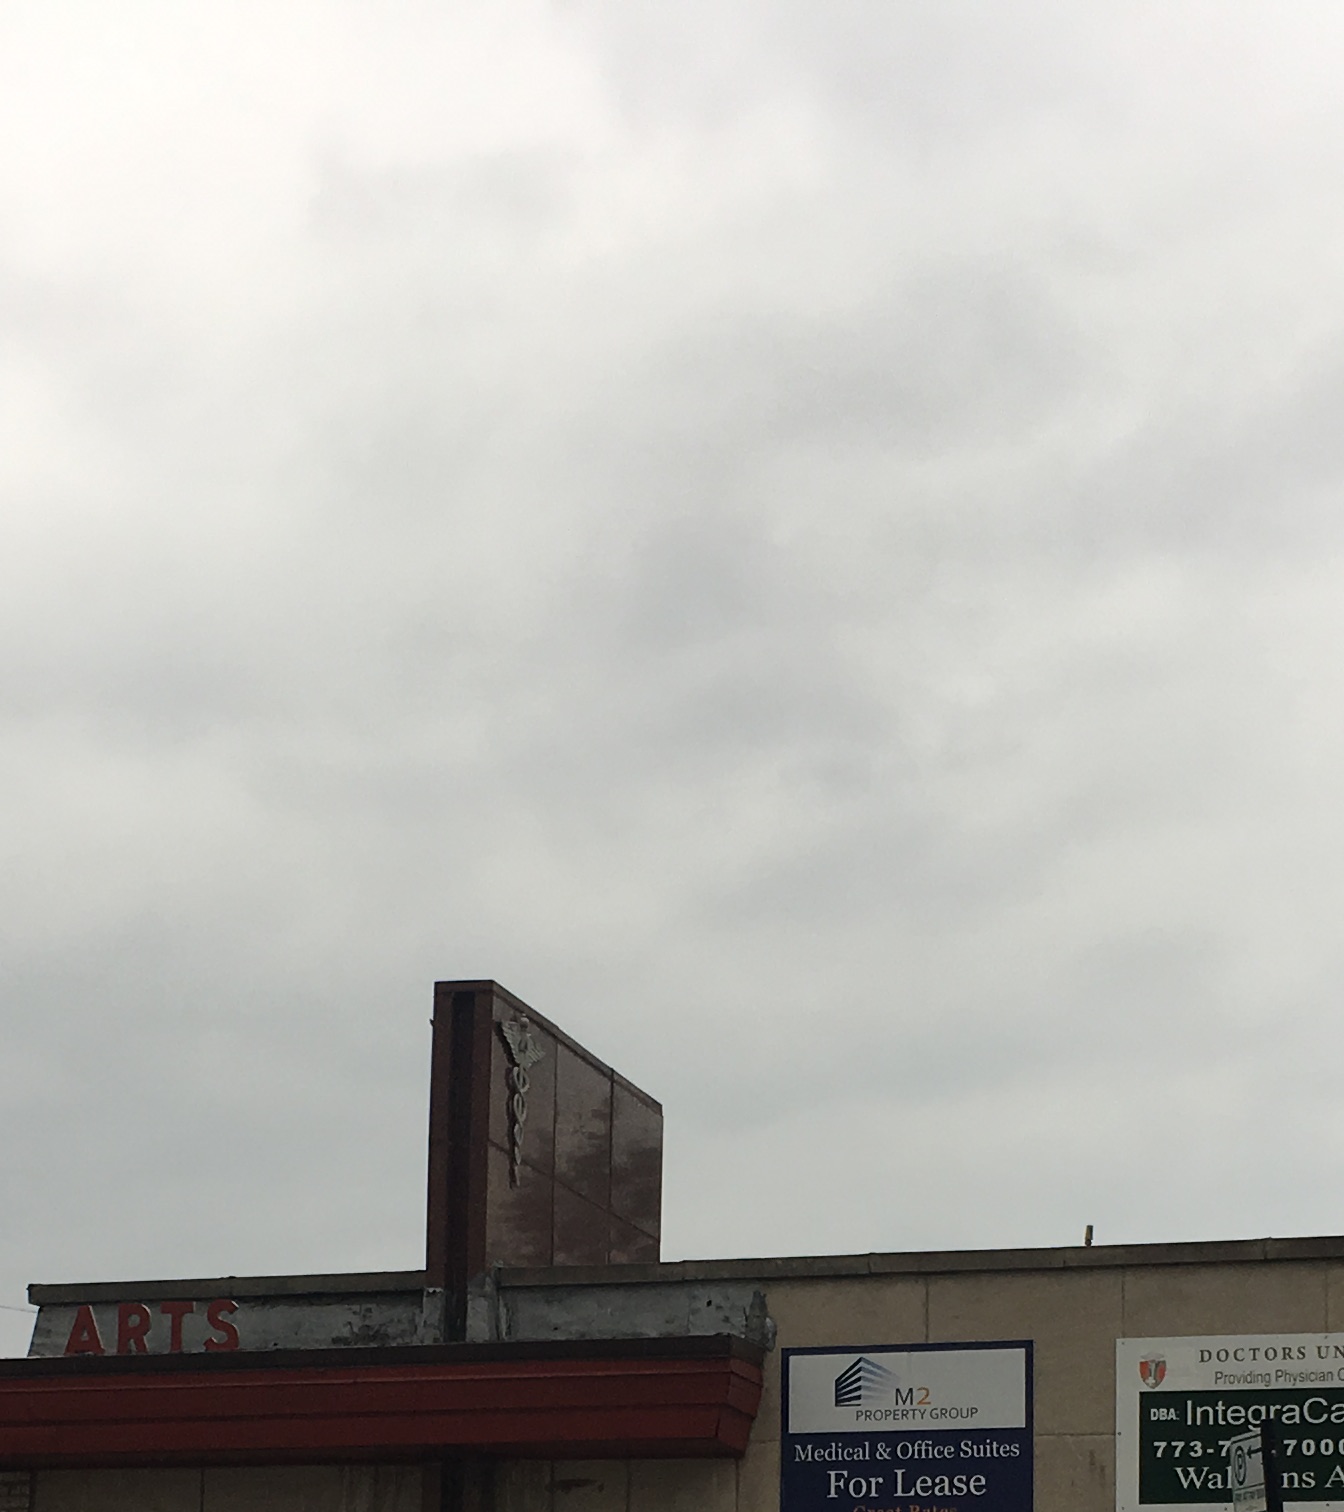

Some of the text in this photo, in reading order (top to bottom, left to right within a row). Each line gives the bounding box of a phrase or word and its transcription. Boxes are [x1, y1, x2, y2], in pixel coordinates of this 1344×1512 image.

[63, 1299, 241, 1358] ARTS
[1198, 1346, 1306, 1364] DOCTORS
[1214, 1371, 1272, 1387] Providing
[1275, 1369, 1334, 1385] Physician
[855, 1407, 978, 1421] PROPERTY GROUP
[1150, 1408, 1179, 1421] DBA:
[794, 1438, 1020, 1462] Medical & Office Suites
[826, 1468, 987, 1499] For Lease
